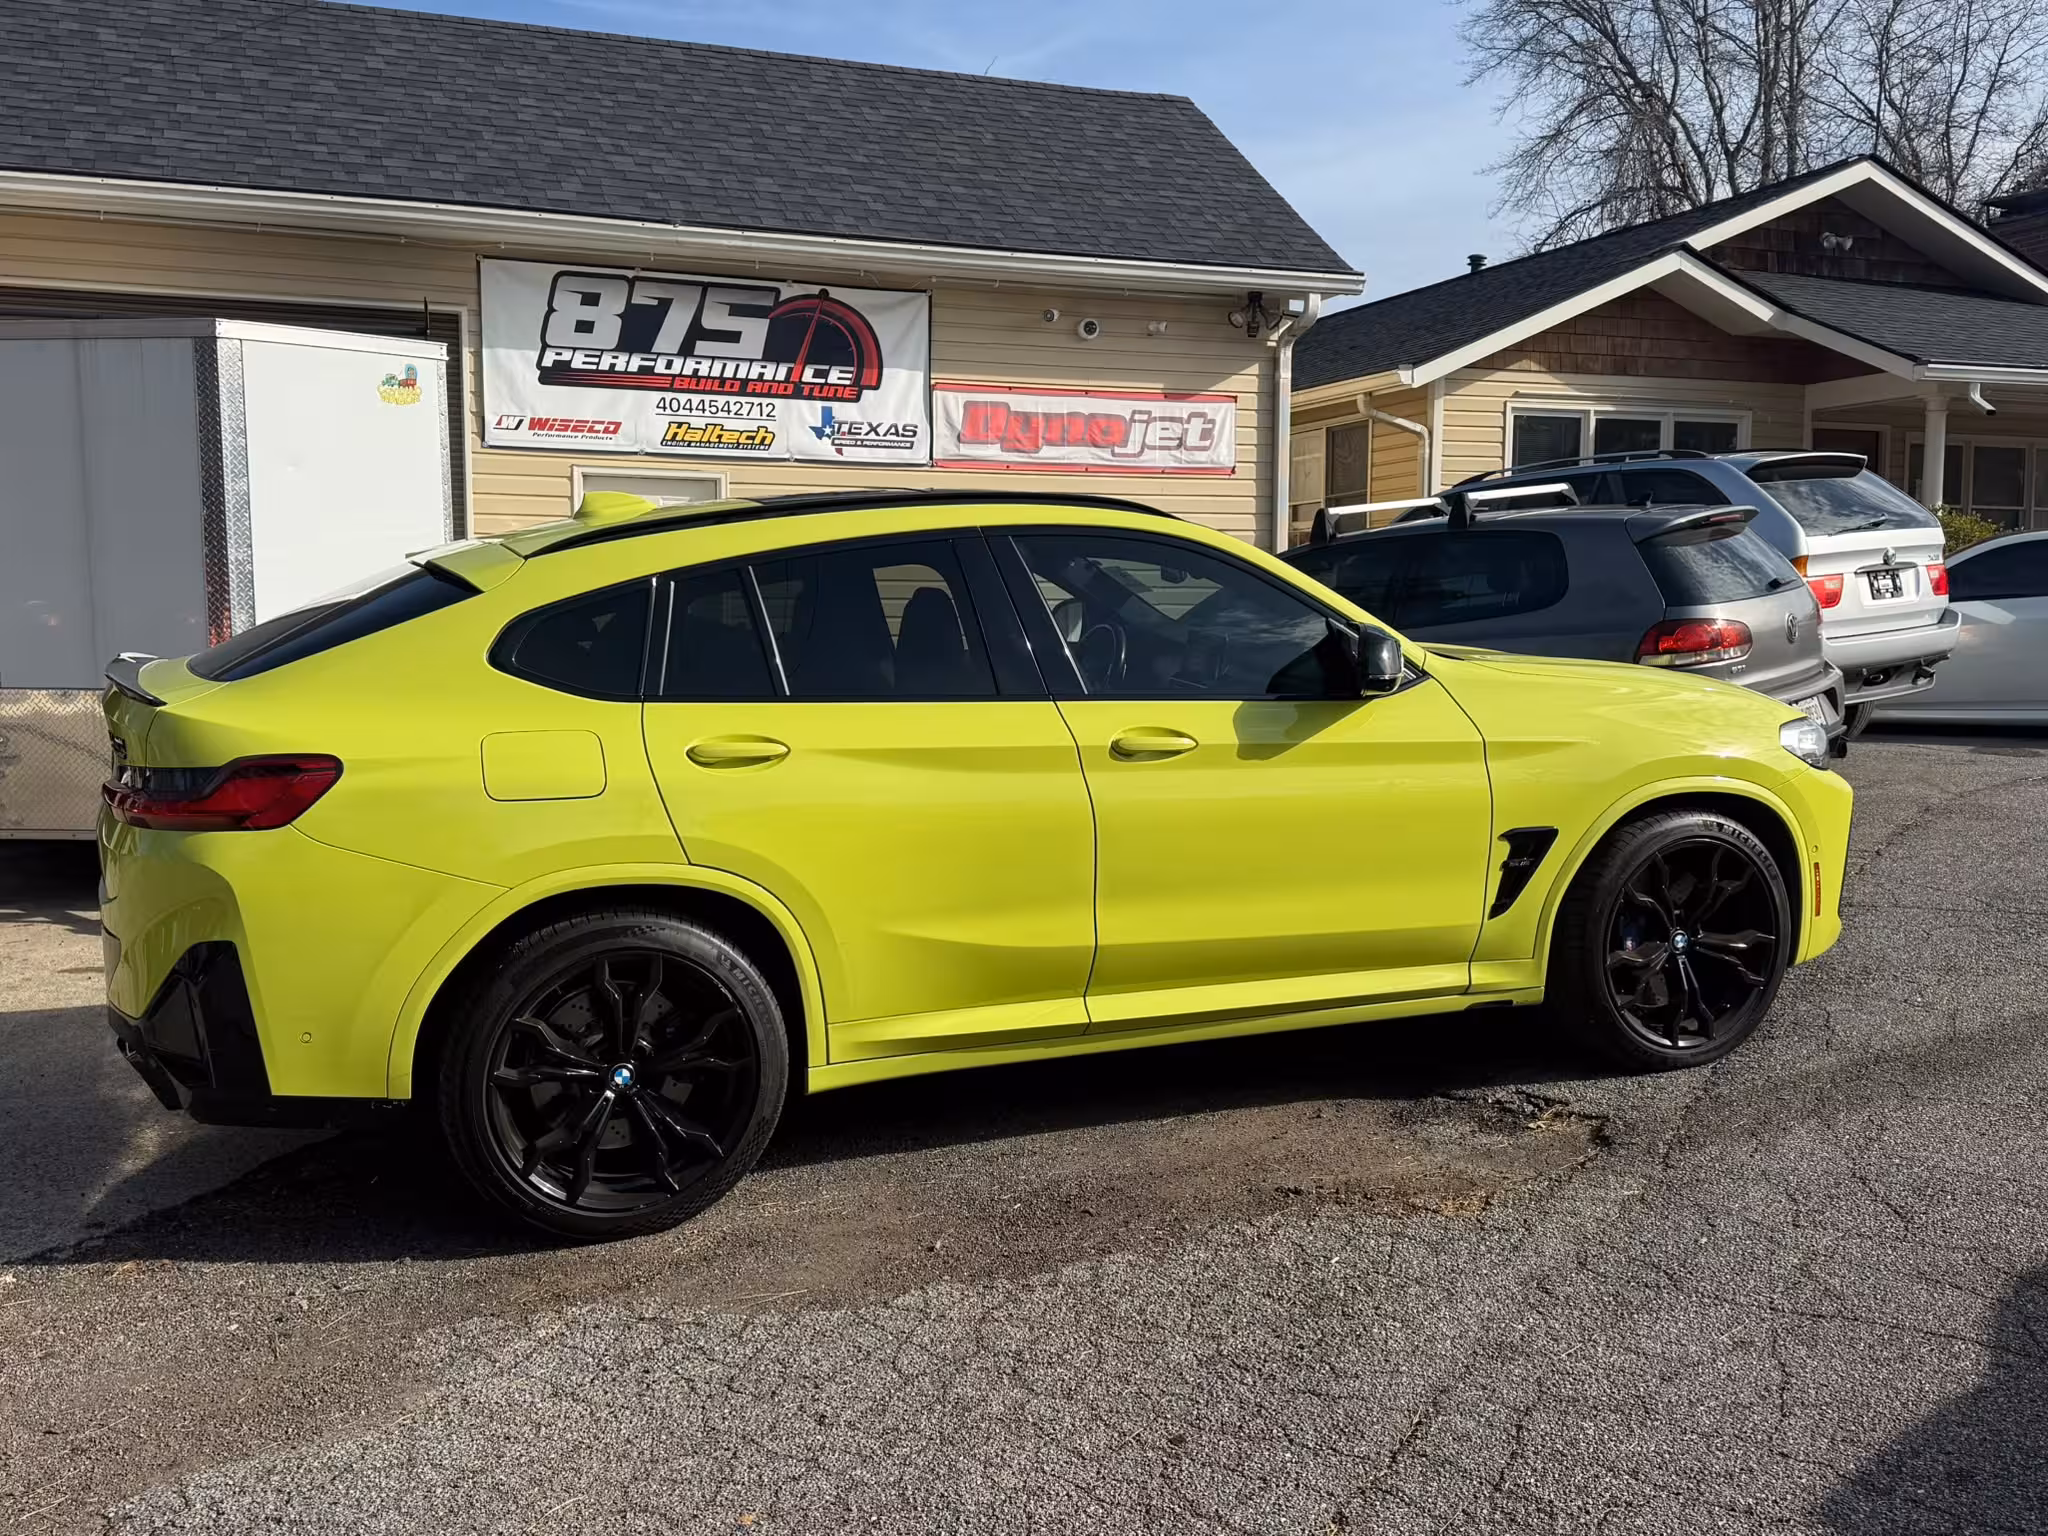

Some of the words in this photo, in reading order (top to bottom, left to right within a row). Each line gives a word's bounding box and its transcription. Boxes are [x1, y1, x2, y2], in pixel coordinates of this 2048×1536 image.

[546, 276, 776, 359] 875
[541, 347, 855, 385] PERFORMANCE
[673, 376, 741, 392] BUILD
[747, 381, 794, 395] AND
[801, 385, 859, 399] TUNE
[656, 396, 776, 418] 4044542712
[532, 432, 579, 440] Performance
[664, 422, 775, 445] Haltech
[833, 420, 918, 438] TEXAS
[960, 401, 1216, 458] Dynojet
[689, 441, 738, 449] MANAGEMENT
[1721, 824, 1778, 878] MICHELIN
